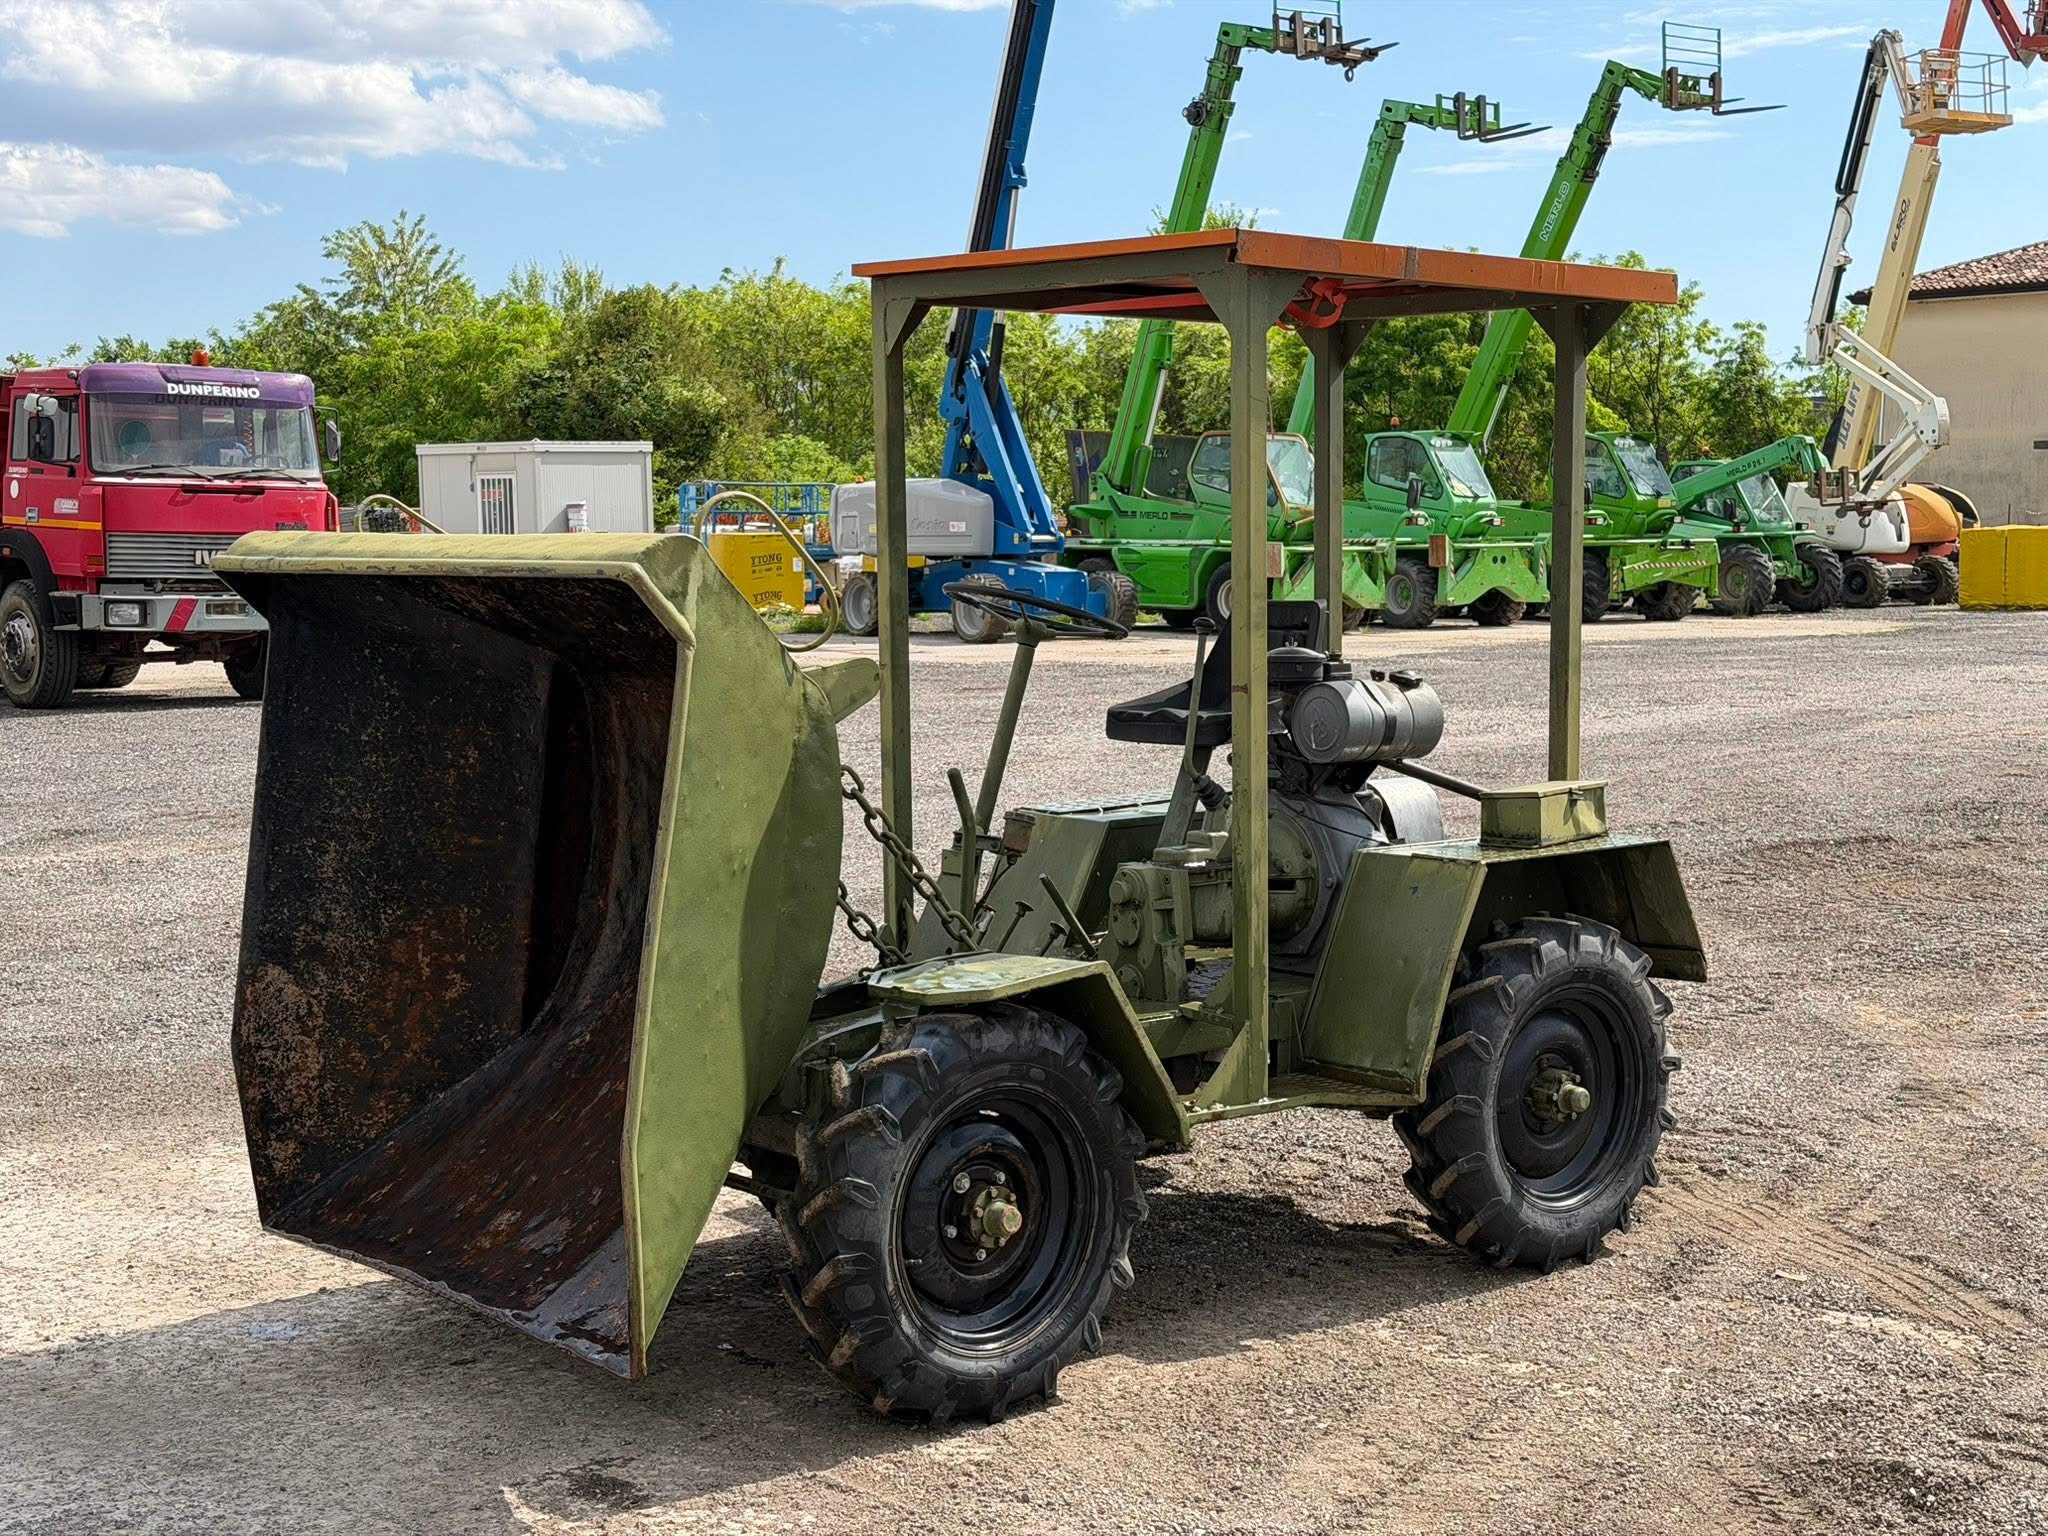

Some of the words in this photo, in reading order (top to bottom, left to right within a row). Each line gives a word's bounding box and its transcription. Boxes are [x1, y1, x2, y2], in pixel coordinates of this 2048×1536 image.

[1539, 181, 1570, 241] MERLO
[167, 383, 260, 399] DUNPERINO
[1846, 381, 1861, 418] LIFT
[1139, 511, 1169, 521] MERLO
[750, 553, 783, 566] YTONG
[753, 591, 783, 602] YTONG
